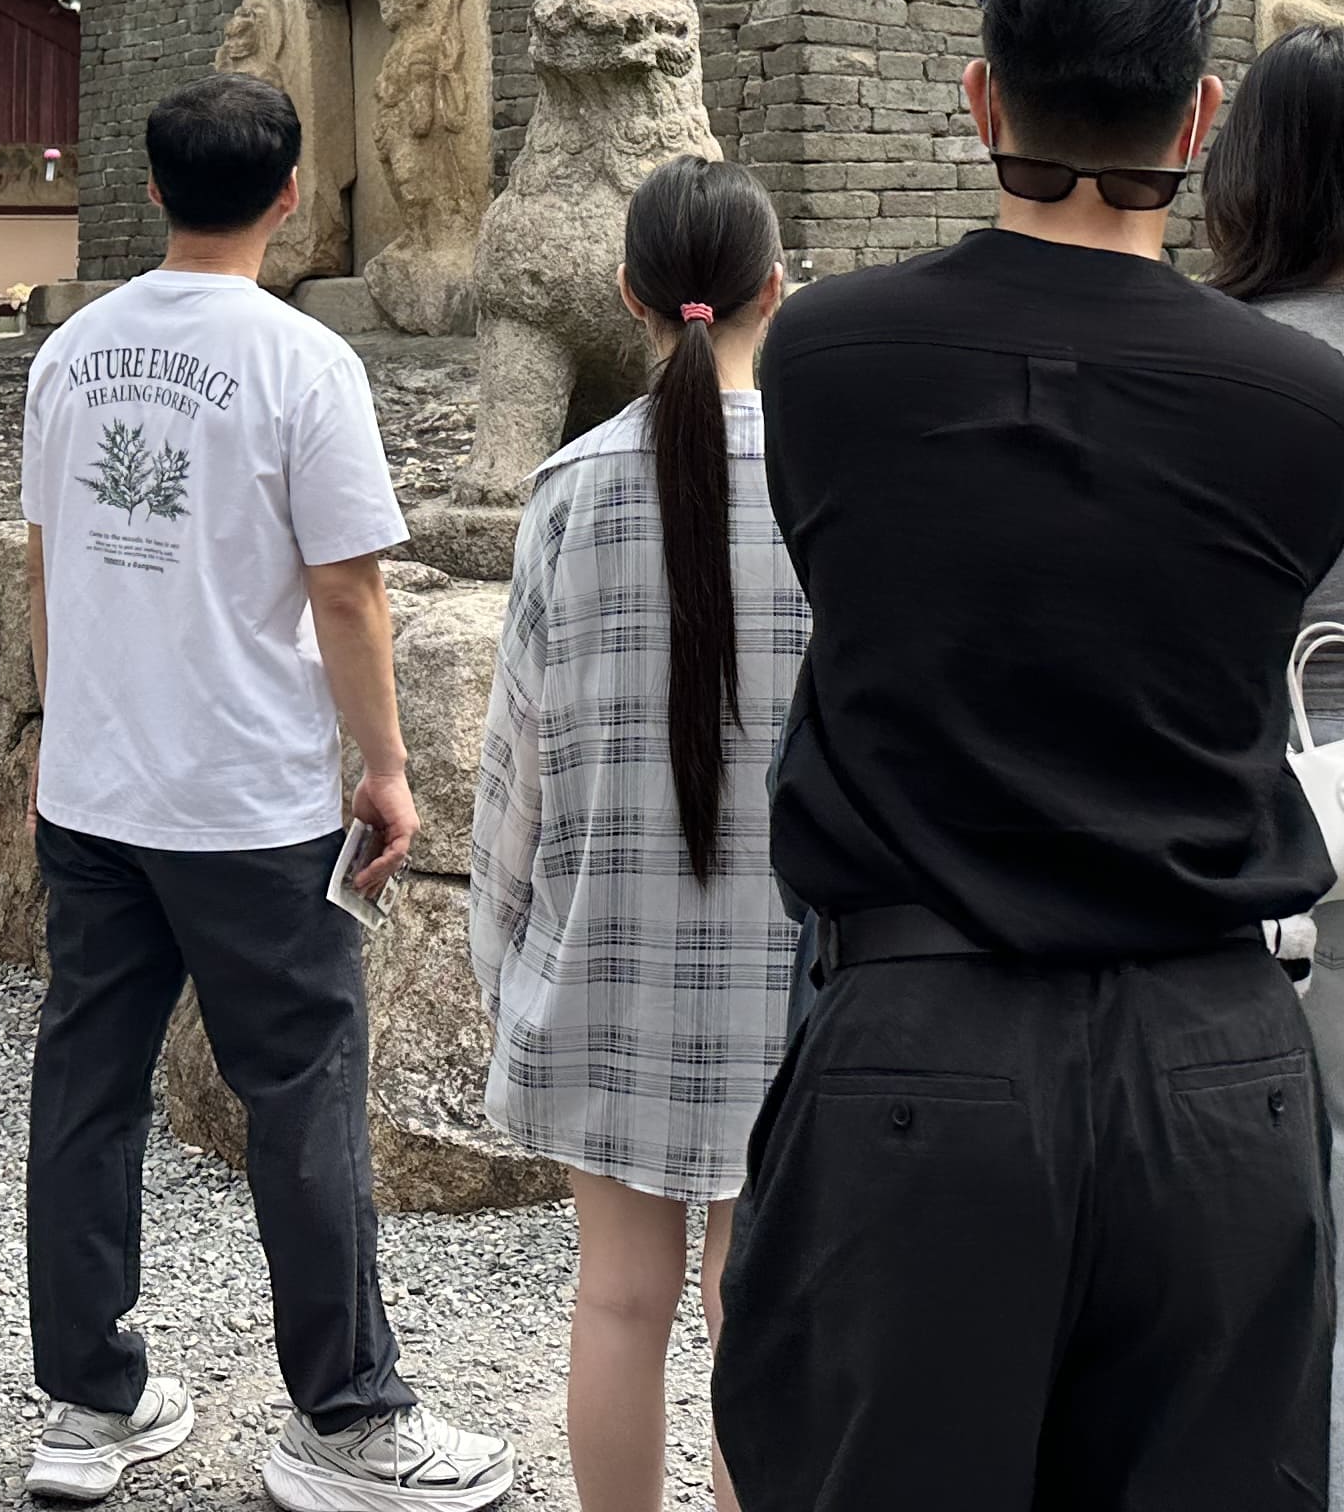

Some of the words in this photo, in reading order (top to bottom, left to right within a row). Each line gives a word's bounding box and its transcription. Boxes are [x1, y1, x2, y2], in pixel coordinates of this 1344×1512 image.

[68, 347, 146, 391] NATURE
[146, 348, 240, 411] EMBRACE
[85, 384, 154, 408] HEALING
[155, 386, 201, 420] FOREST
